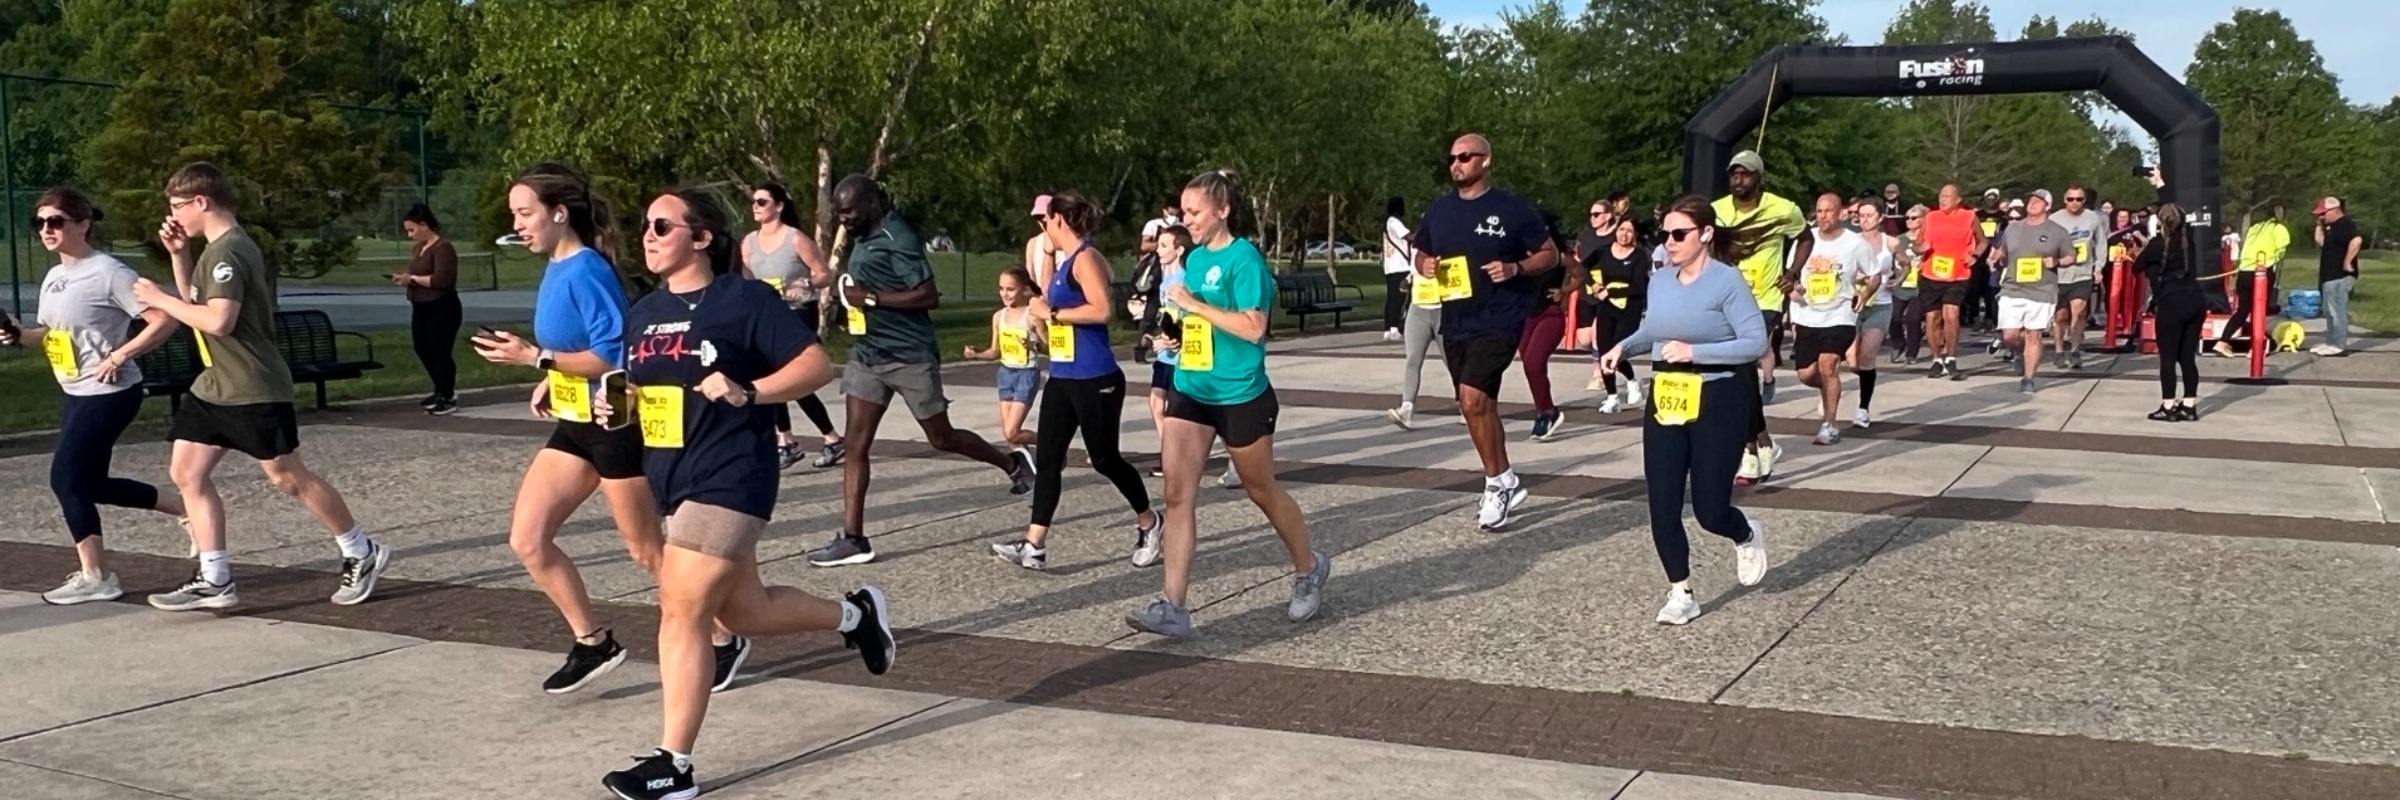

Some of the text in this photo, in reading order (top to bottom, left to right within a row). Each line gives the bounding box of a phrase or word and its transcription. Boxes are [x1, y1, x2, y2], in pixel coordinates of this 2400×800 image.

[1899, 57, 1984, 78] Fusion
[1939, 75, 1983, 86] racing
[1659, 395, 1688, 412] 6574
[646, 776, 674, 791] HOKA
